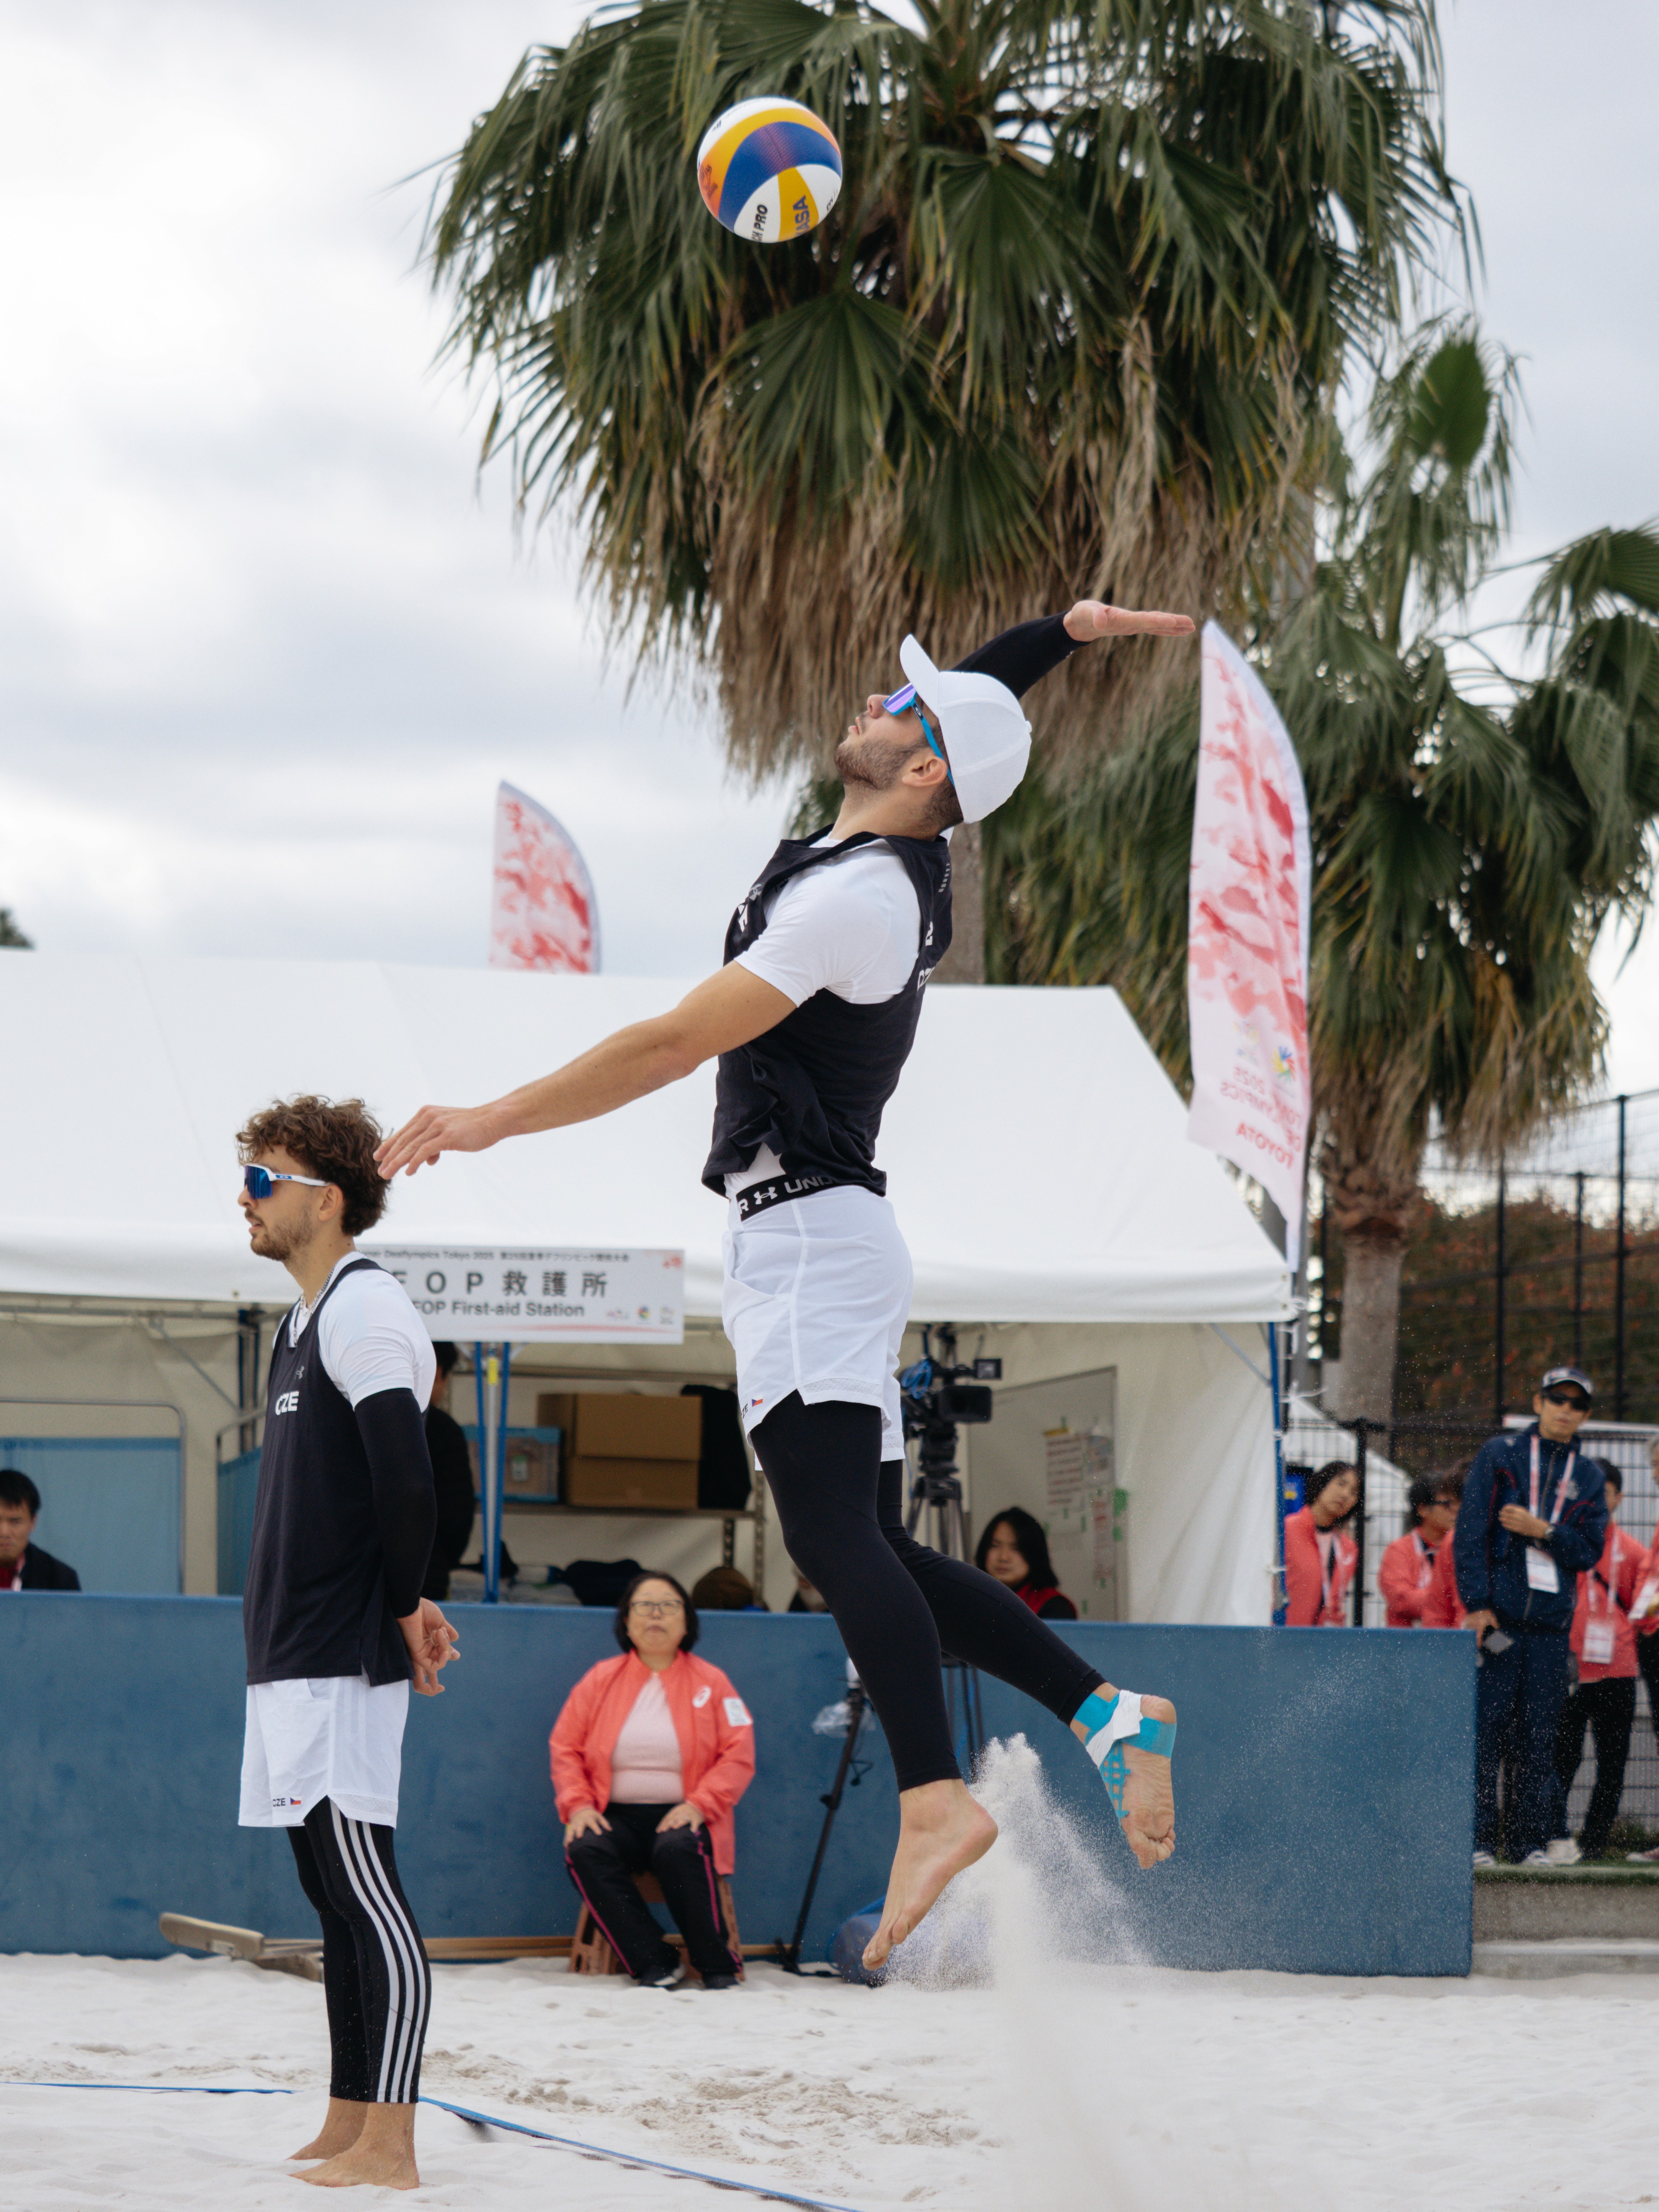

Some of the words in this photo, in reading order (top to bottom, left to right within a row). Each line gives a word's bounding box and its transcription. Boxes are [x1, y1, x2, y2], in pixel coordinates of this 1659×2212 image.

[793, 195, 810, 234] ASA
[784, 1176, 834, 1193] UND
[451, 1301, 520, 1316] First-aid
[526, 1302, 585, 1317] Station
[275, 1391, 299, 1415] CZE
[272, 1798, 286, 1807] CZE
